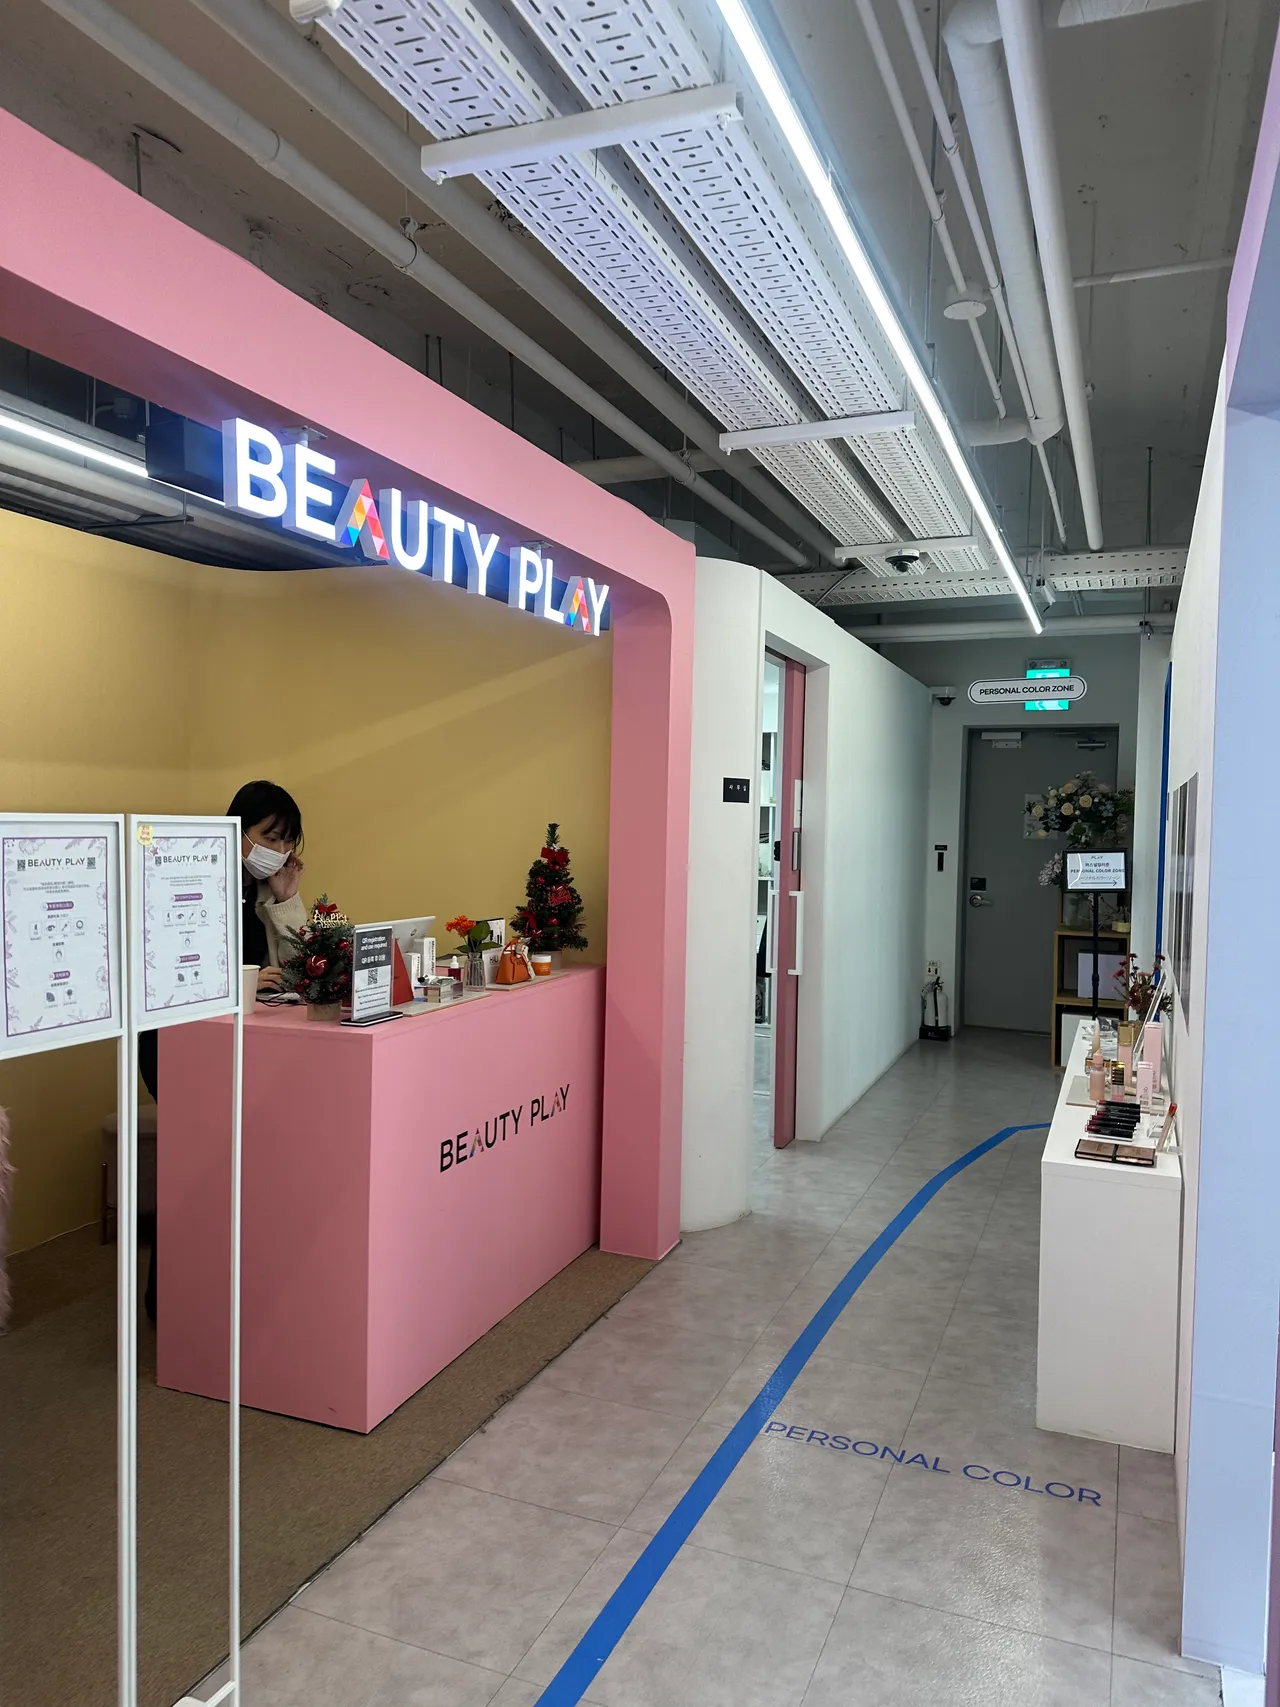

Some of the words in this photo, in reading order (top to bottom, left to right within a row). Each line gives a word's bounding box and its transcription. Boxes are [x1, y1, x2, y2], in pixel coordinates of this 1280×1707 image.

[226, 417, 500, 597] BEAUTY
[511, 546, 610, 637] PLAY
[979, 687, 1021, 696] PERSONAL
[1022, 686, 1051, 694] COLOR
[1052, 684, 1075, 693] ZONE
[27, 858, 62, 868] BEAUTY
[65, 857, 85, 866] PLAY
[163, 855, 190, 863] BEAUTY
[440, 1105, 523, 1173] BEAUTY
[530, 1083, 570, 1127] PLAY
[764, 1421, 951, 1474] PERSONAL
[962, 1464, 1102, 1507] COLOR
